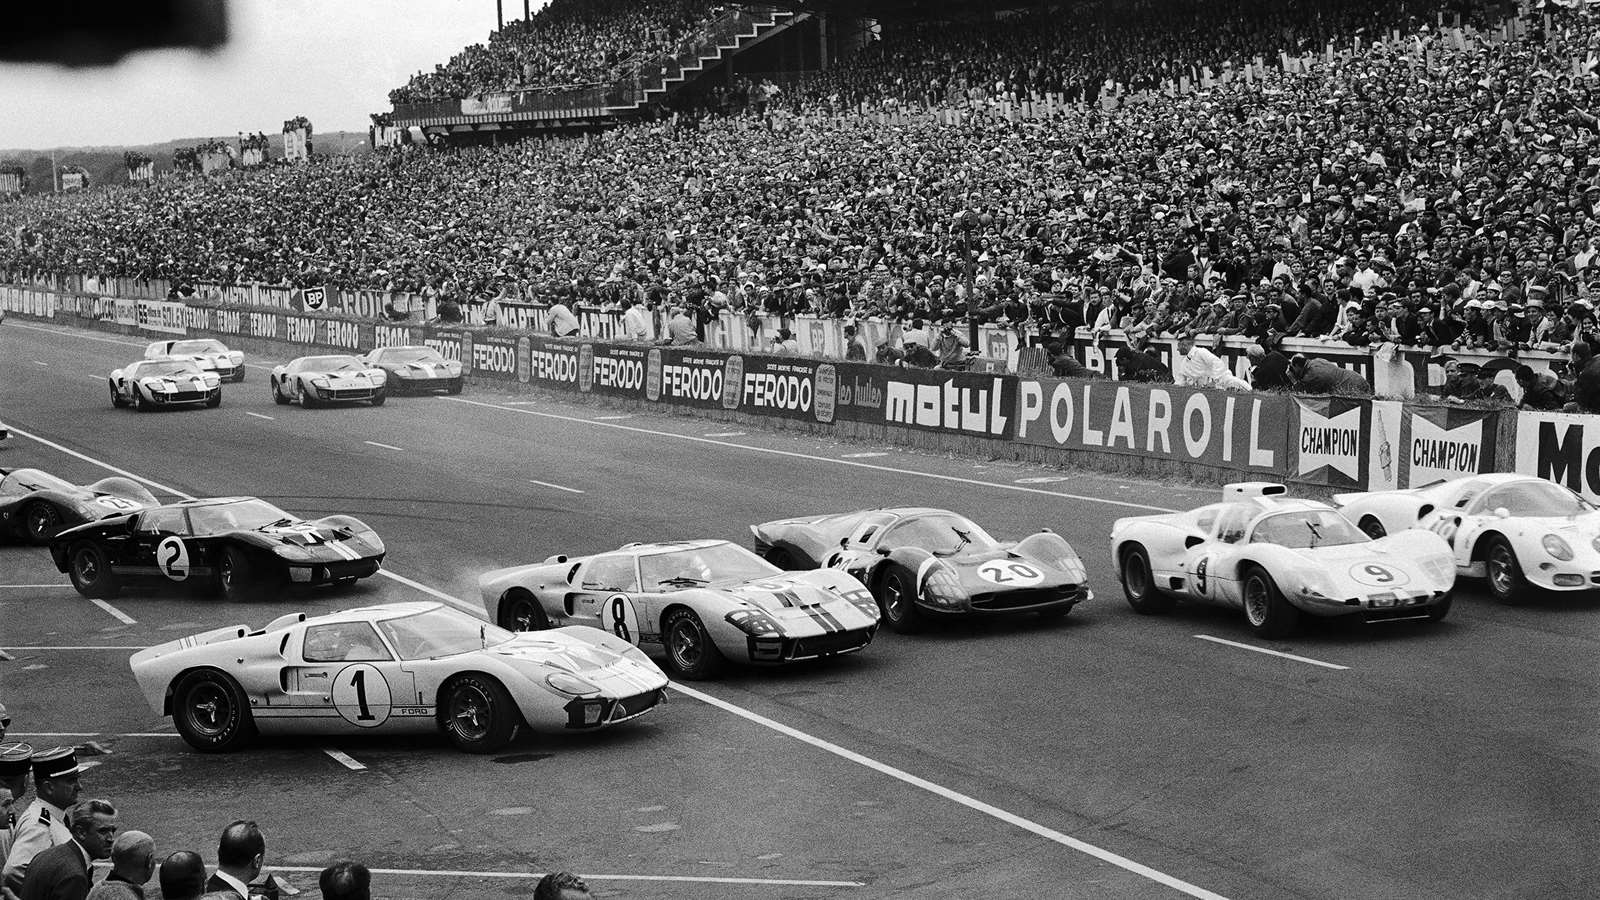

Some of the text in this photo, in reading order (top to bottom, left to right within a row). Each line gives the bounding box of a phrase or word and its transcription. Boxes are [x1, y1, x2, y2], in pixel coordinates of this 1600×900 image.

[260, 288, 290, 310] MARTIN
[307, 292, 322, 305] BP
[186, 306, 209, 330] FERODO
[217, 310, 240, 333] FERODO
[250, 313, 277, 338] FERODO
[287, 317, 316, 344] FERODO
[499, 307, 549, 333] MARTIN
[578, 312, 627, 340] ARTIN
[327, 320, 359, 349] FERODO
[424, 339, 461, 361] RODO
[473, 343, 515, 373] FERODO
[531, 350, 577, 382] FERODO
[593, 356, 643, 390] FERODO
[663, 364, 723, 401] FERODO
[743, 372, 811, 412] FERODO
[1018, 381, 1275, 468] POLAROIL
[1301, 426, 1357, 457] CHAMPION
[1412, 437, 1478, 473] CHAMPION
[164, 540, 186, 577] 2
[983, 563, 1039, 584] 20
[1363, 564, 1395, 583] 9
[611, 597, 631, 645] 8
[350, 670, 376, 721] 1
